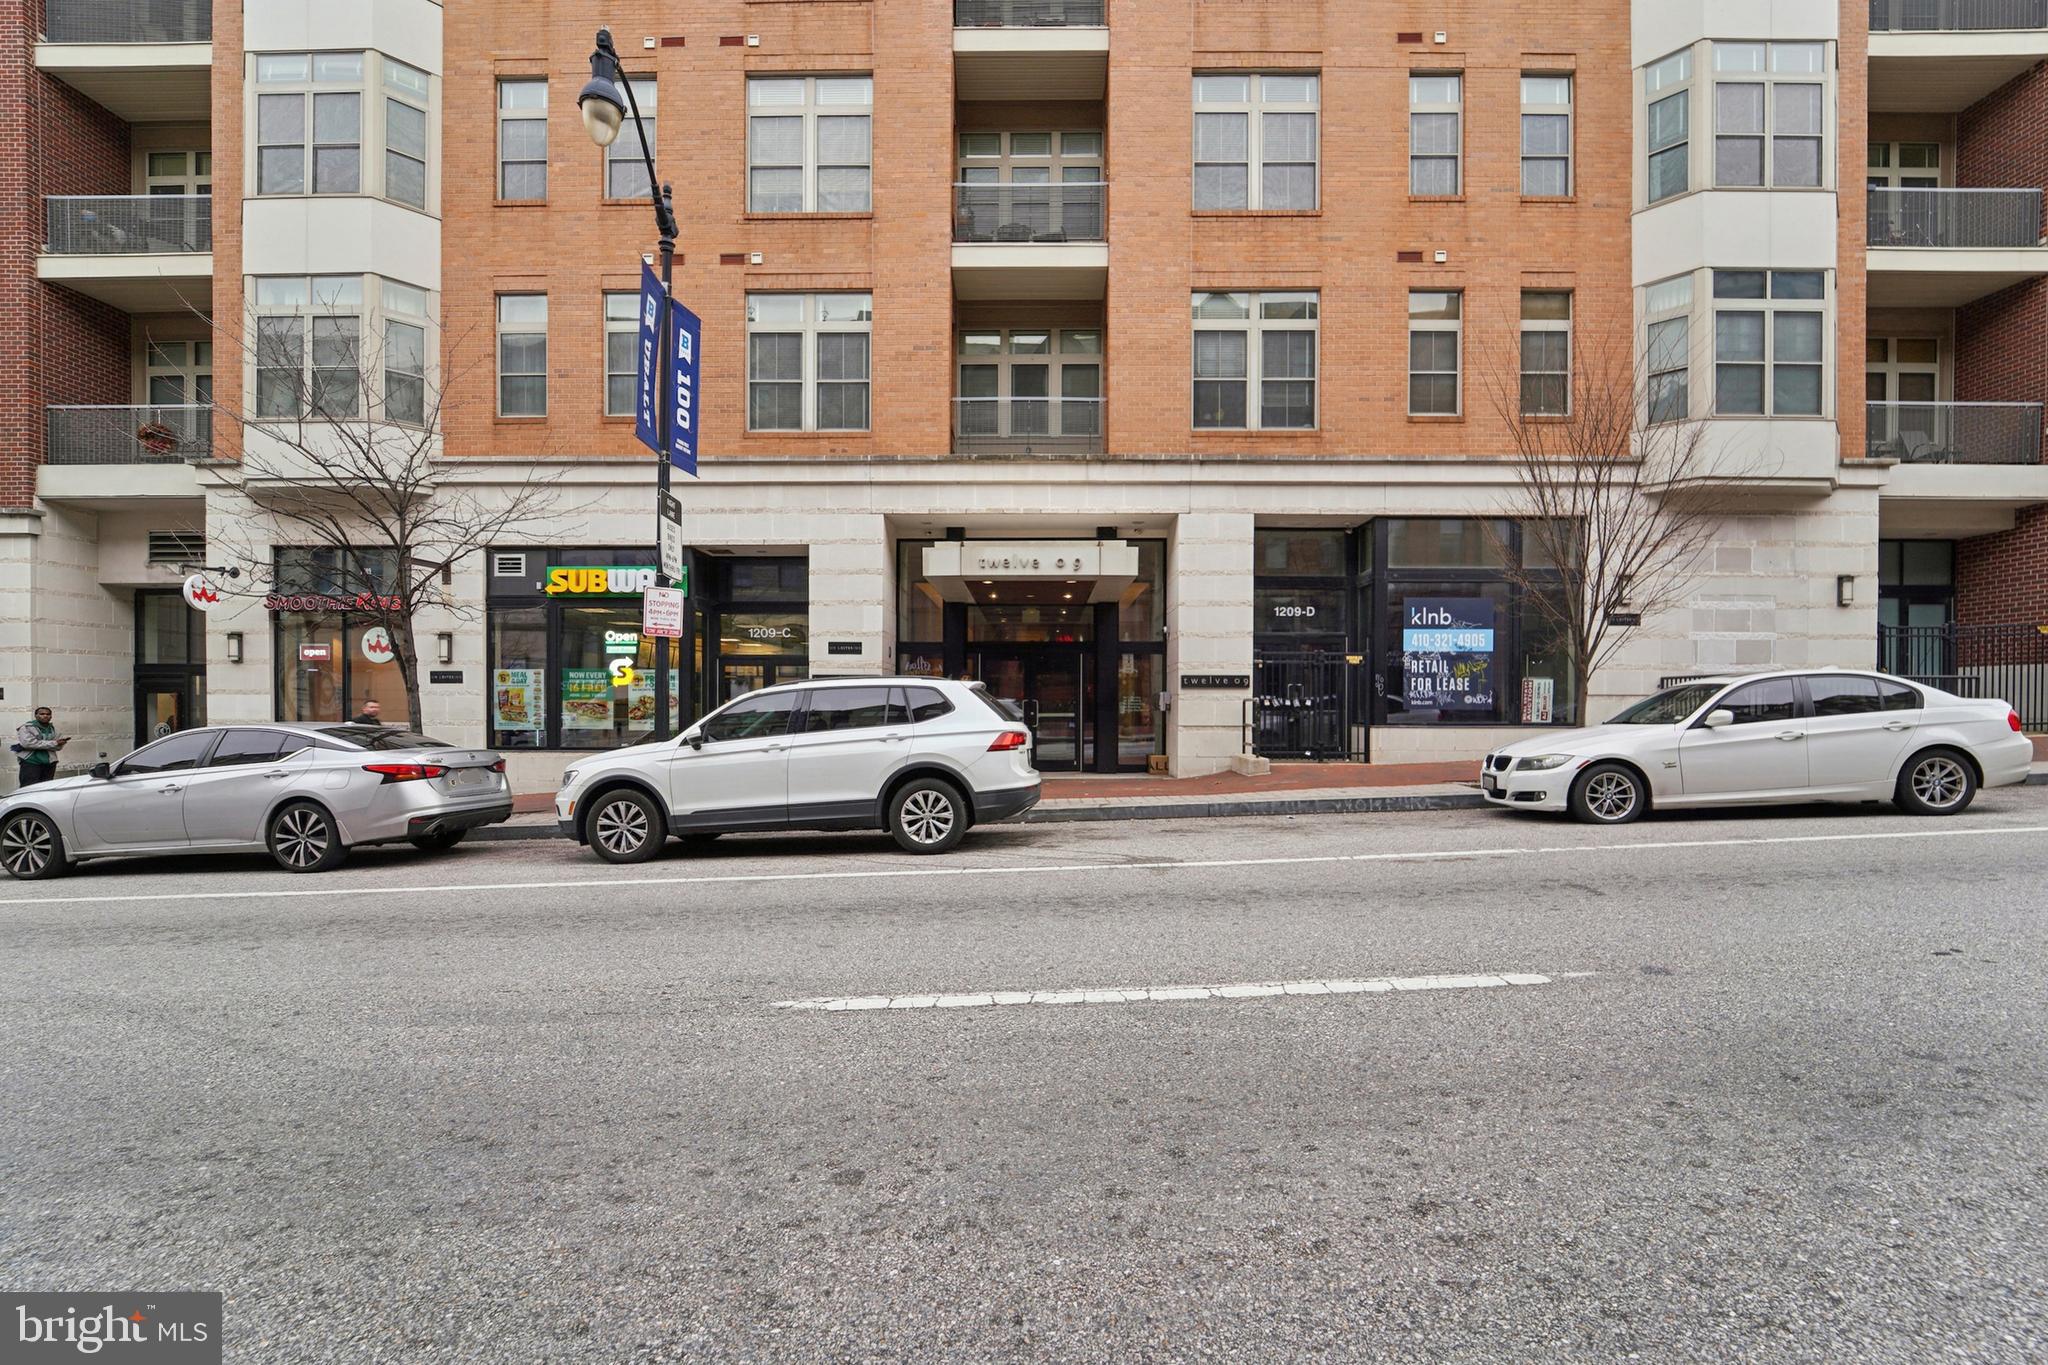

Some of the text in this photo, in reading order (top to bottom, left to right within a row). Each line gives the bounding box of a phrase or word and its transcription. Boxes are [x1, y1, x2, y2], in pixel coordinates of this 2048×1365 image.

[643, 338, 652, 429] UBALT
[676, 369, 691, 431] 100
[979, 553, 1040, 570] twelve
[545, 568, 658, 595] SUBWA
[648, 600, 680, 609] STOPPING
[1273, 606, 1316, 617] 1209-D
[1411, 606, 1452, 625] klnb
[604, 630, 638, 644] Open
[748, 627, 791, 638] 1209-C
[1411, 632, 1486, 648] 410-321-4905
[303, 649, 327, 658] open
[1411, 659, 1449, 674] RETAIL
[1183, 675, 1229, 685] twelve
[1411, 677, 1470, 691] FOR LEASE
